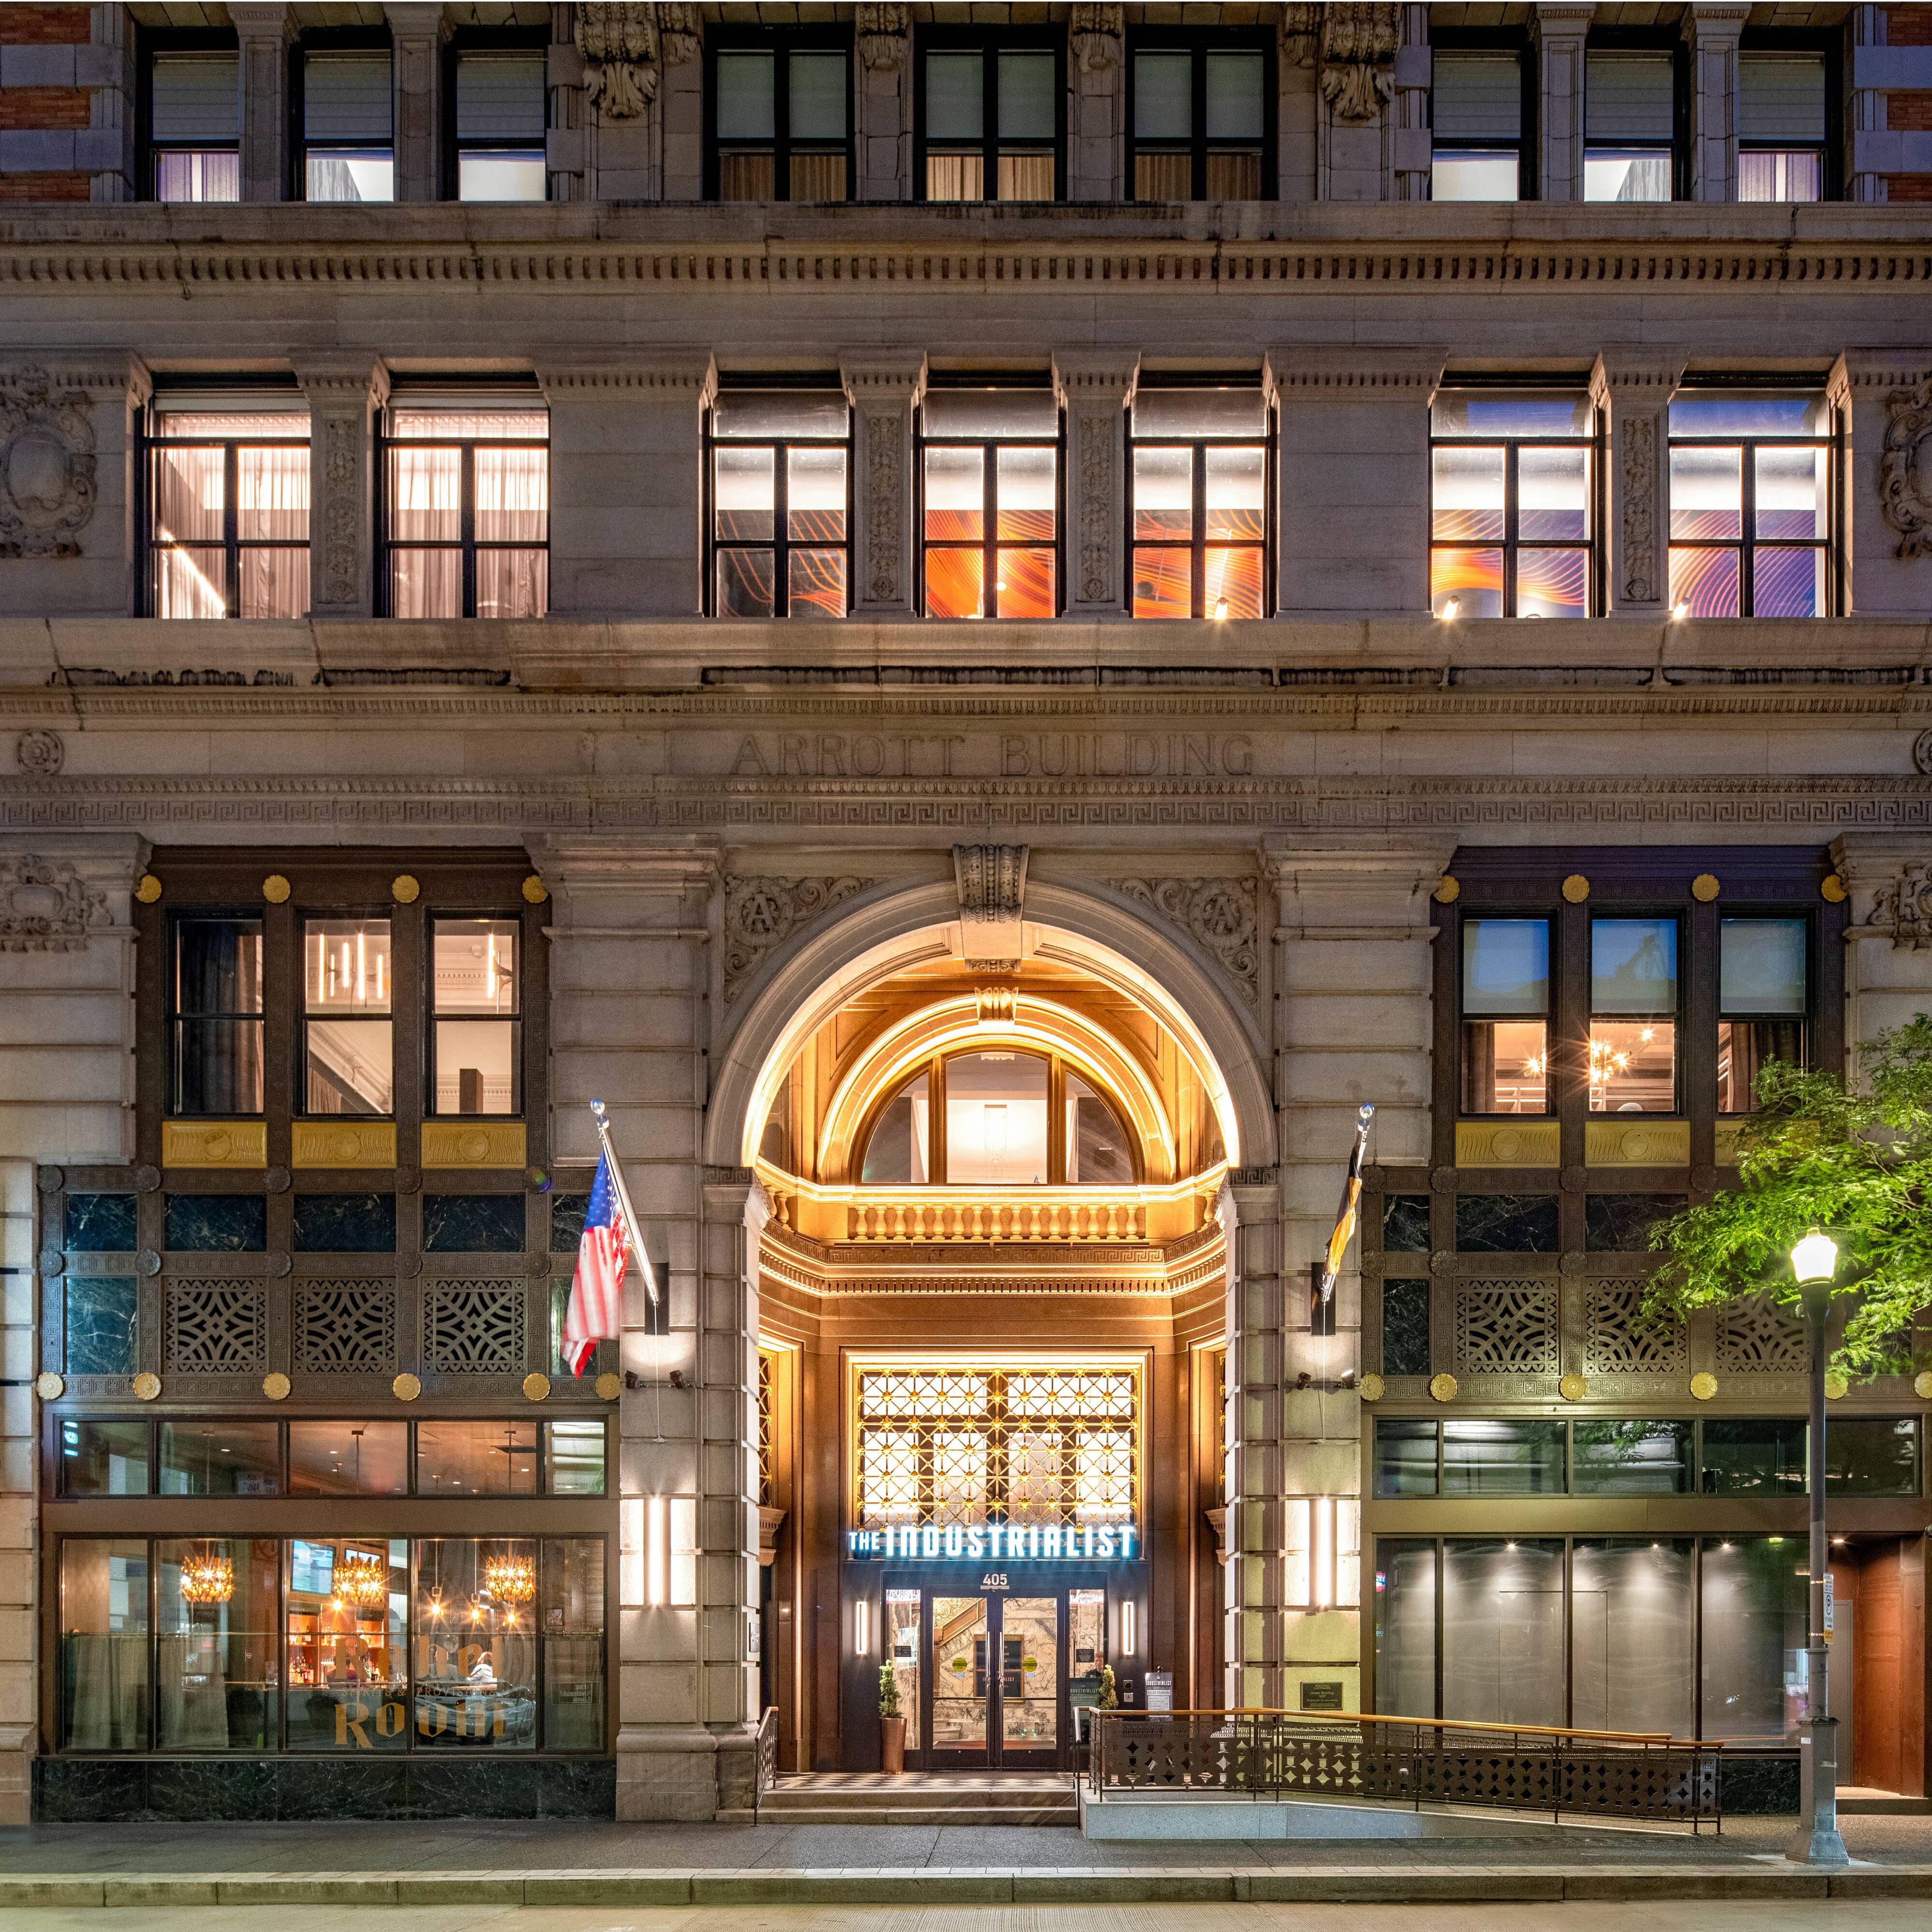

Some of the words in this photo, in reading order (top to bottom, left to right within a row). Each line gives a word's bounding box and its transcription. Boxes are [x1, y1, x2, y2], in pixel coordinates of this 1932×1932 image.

[730, 734, 965, 775] ARROTT
[1000, 735, 1252, 776] BUILDING
[849, 1532, 880, 1550] THE
[886, 1525, 1134, 1557] INDUSTRIALIST
[983, 1573, 1007, 1585] 405
[334, 1635, 503, 1680] Rebel
[342, 1687, 391, 1697] SPIRITS
[397, 1687, 406, 1697] &
[416, 1687, 496, 1697] PROVISIONS
[334, 1702, 505, 1748] Room
